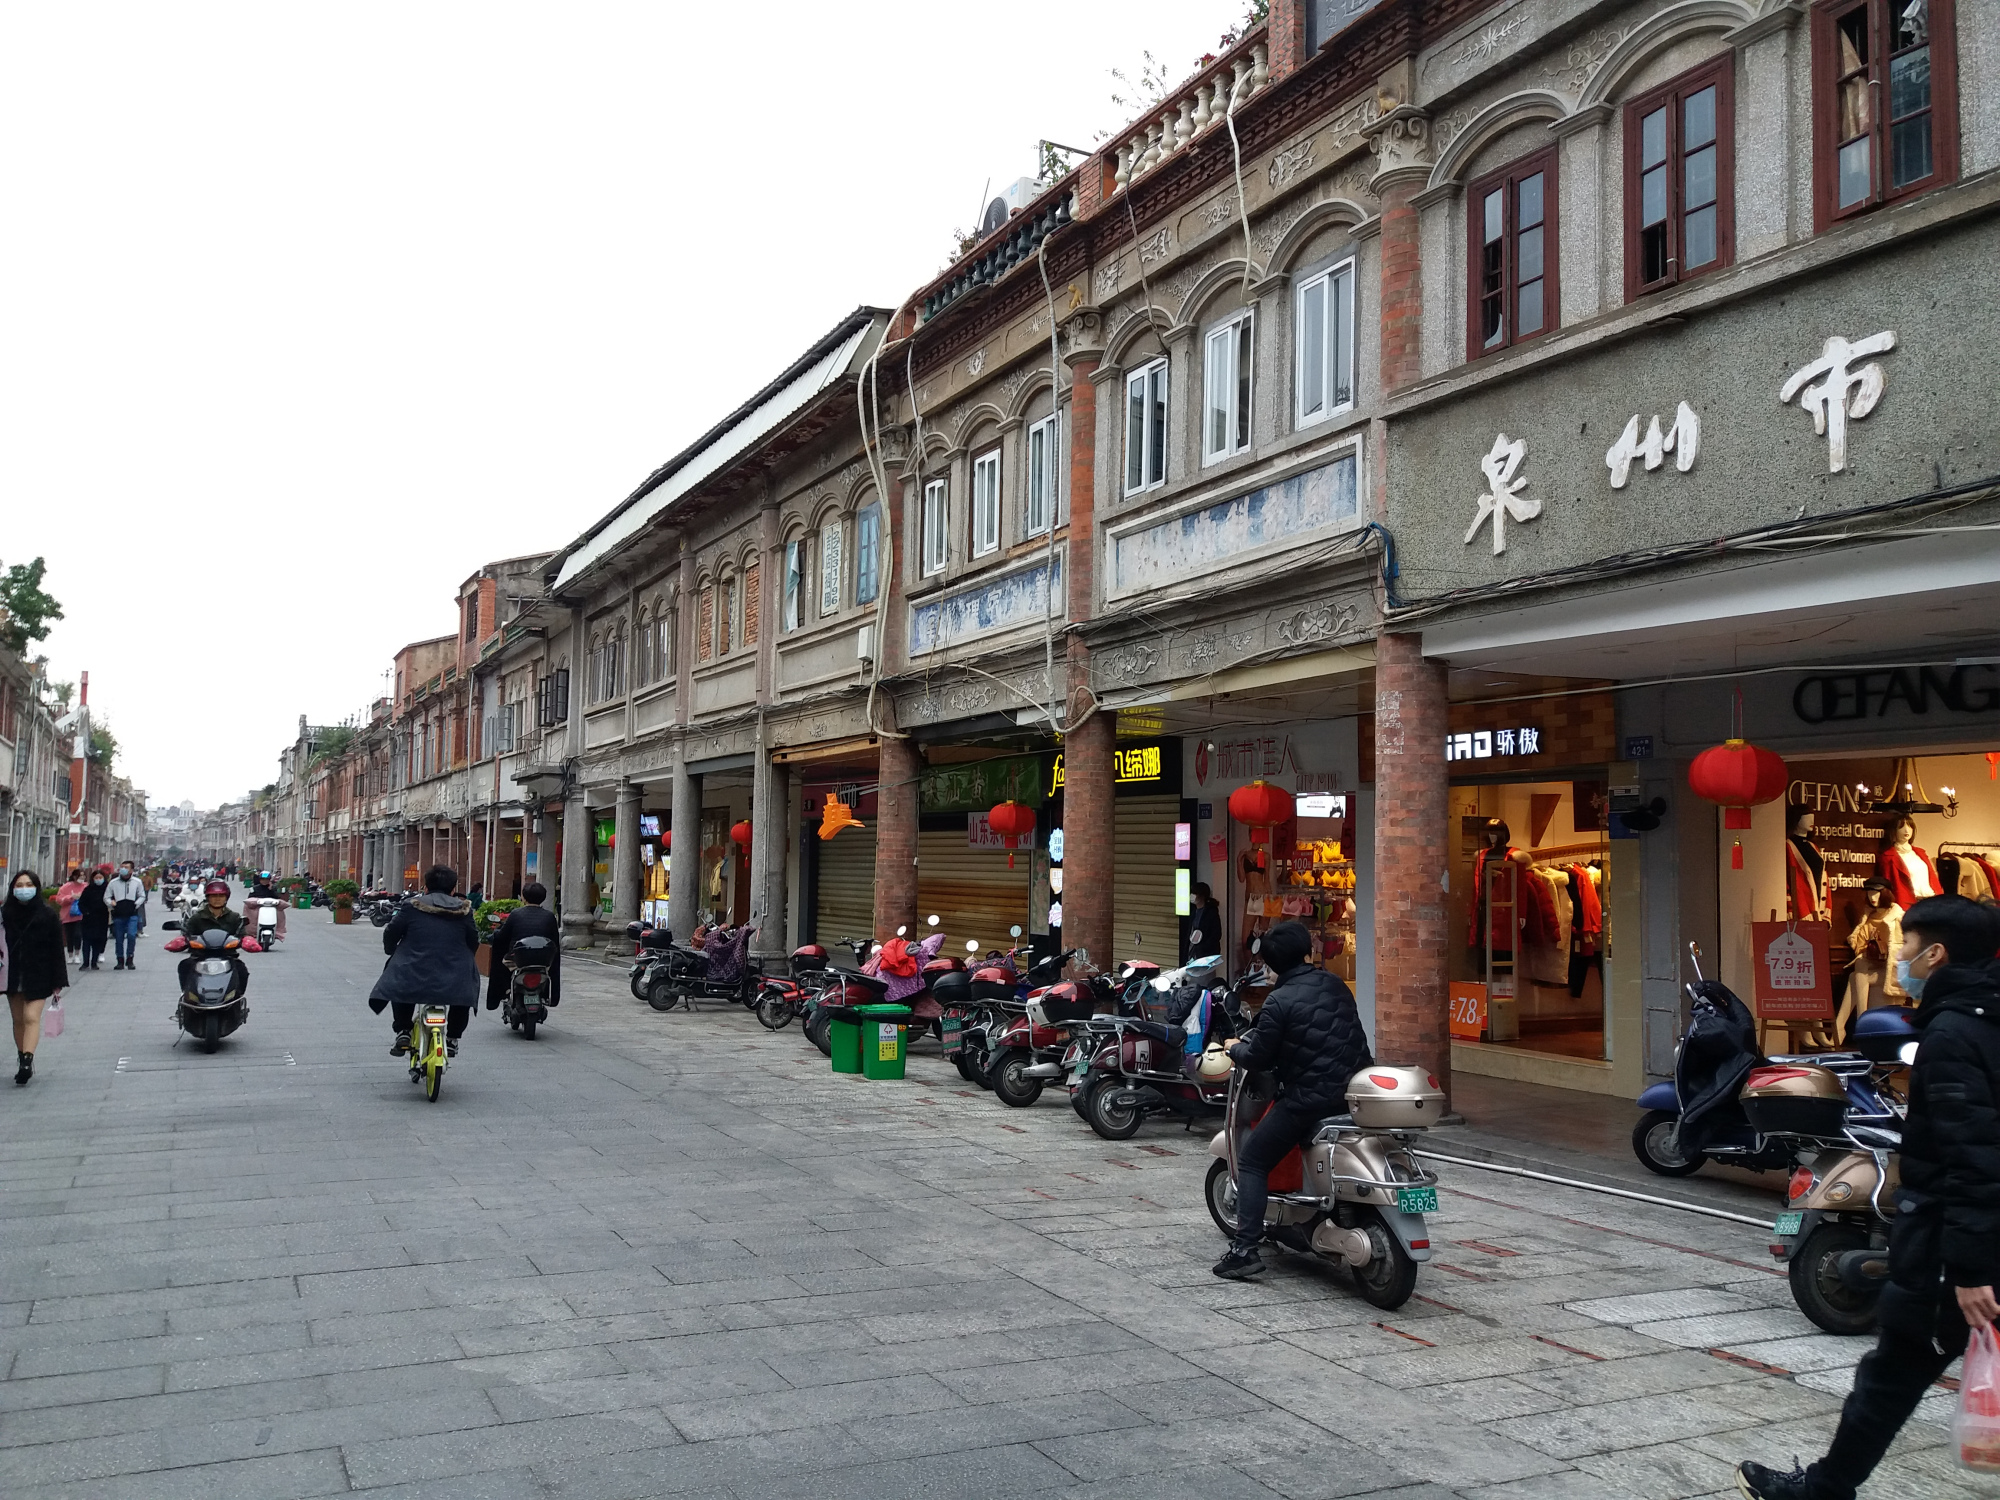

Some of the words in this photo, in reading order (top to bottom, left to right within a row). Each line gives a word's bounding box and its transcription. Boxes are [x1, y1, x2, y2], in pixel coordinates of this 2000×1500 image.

[1497, 727, 1540, 756] 骄傲
[1216, 735, 1298, 779] 城市佳人
[1821, 823, 1852, 840] special
[1854, 824, 1885, 838] Charm
[1840, 848, 1876, 863] Women
[1401, 1196, 1436, 1212] R5825
